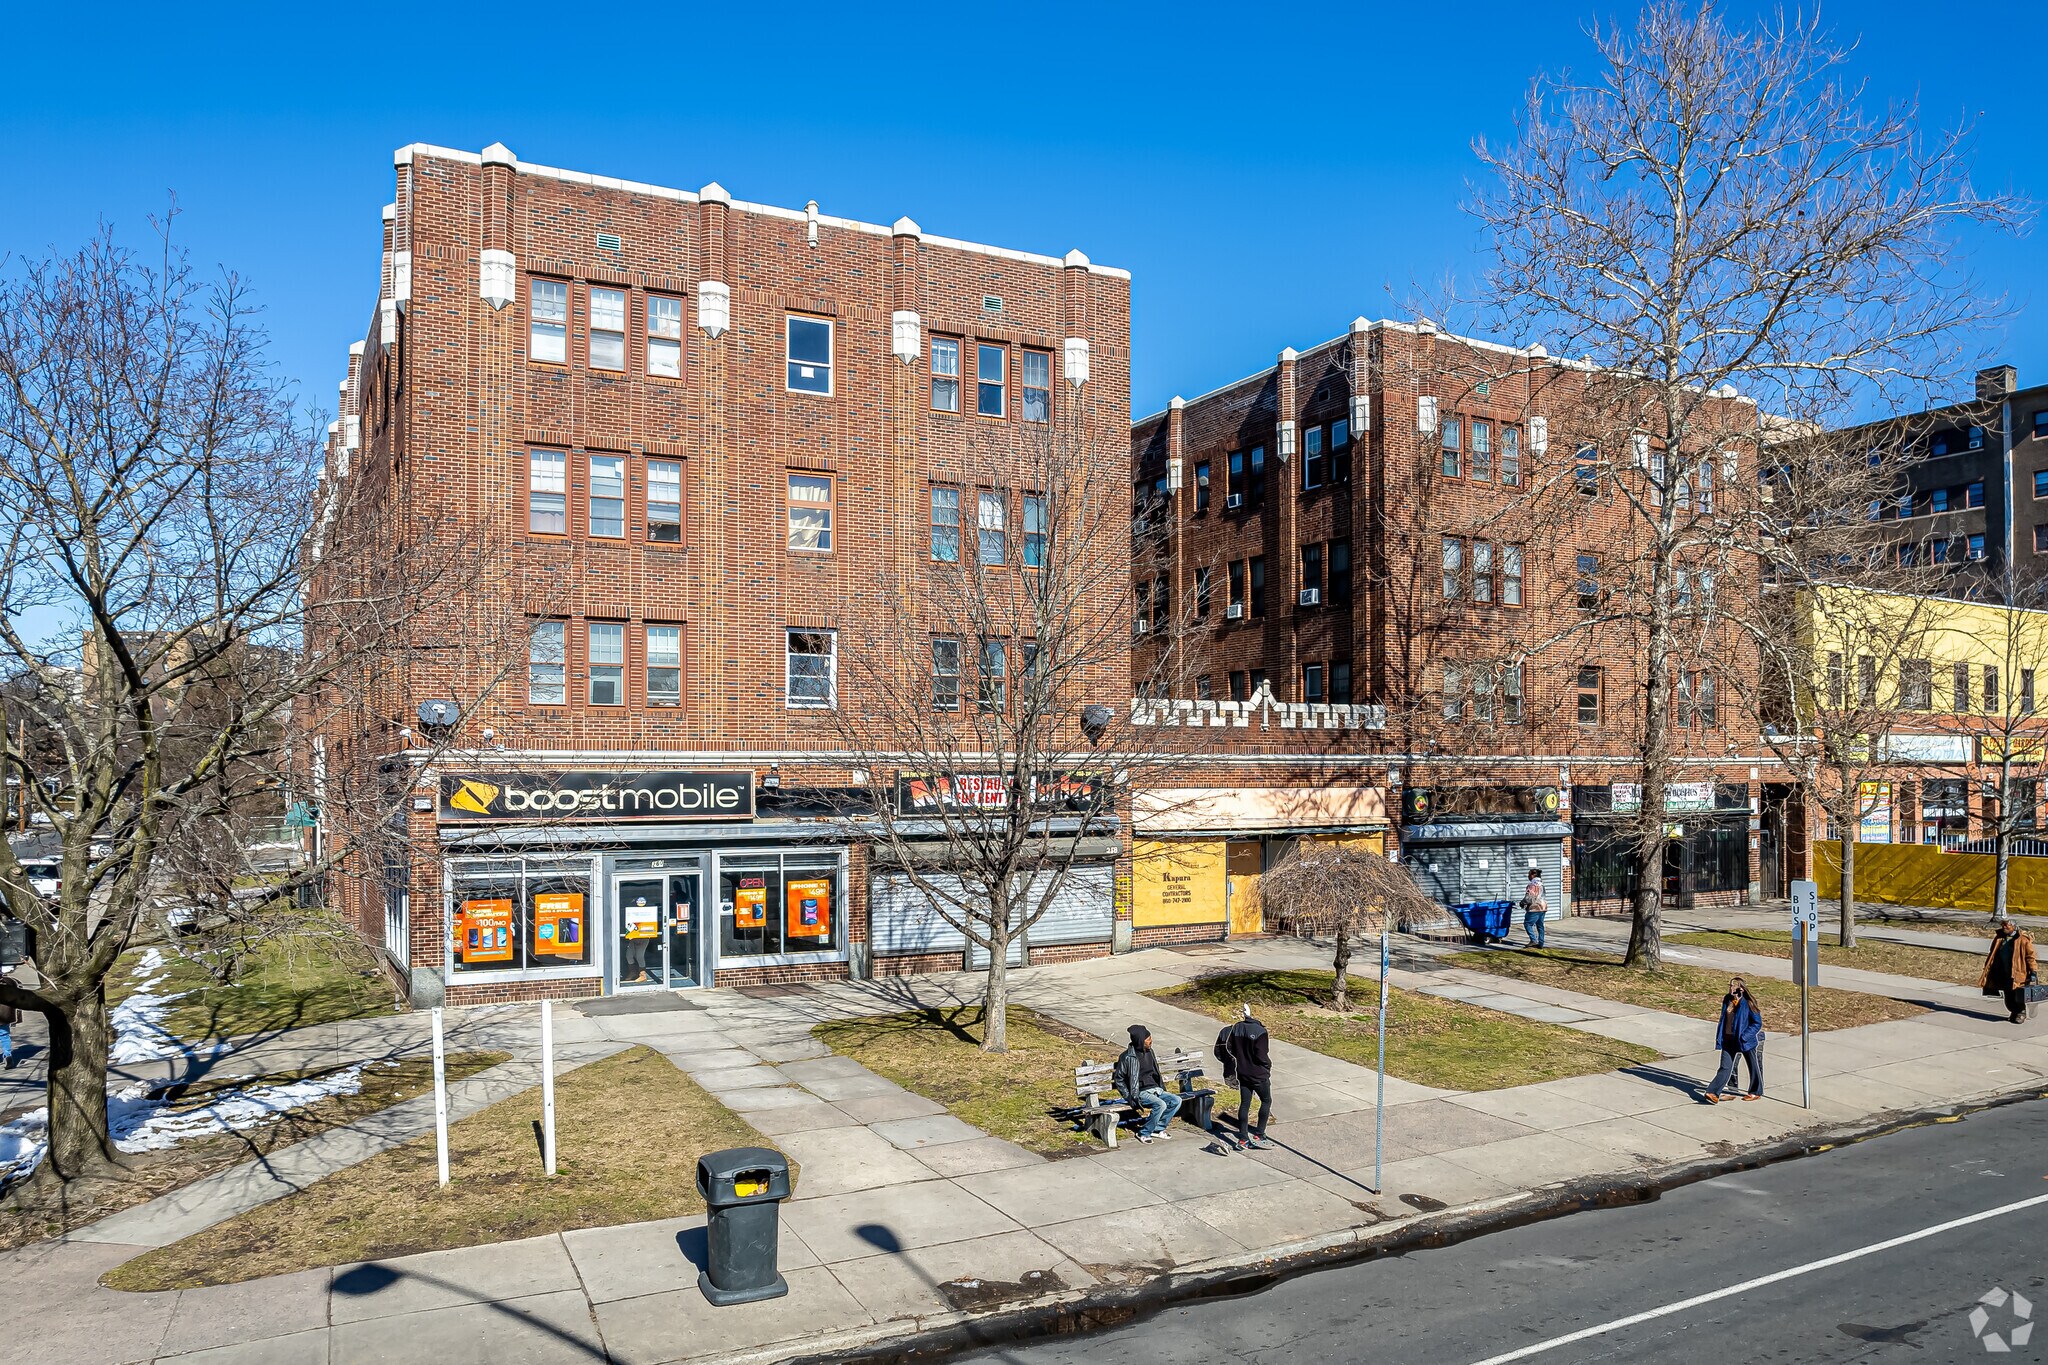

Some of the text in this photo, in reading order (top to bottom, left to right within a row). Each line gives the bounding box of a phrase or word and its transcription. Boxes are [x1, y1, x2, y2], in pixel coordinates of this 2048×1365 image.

[740, 878, 765, 888] OPEN
[1162, 872, 1191, 883] Kapura
[1809, 891, 1817, 932] STOP
